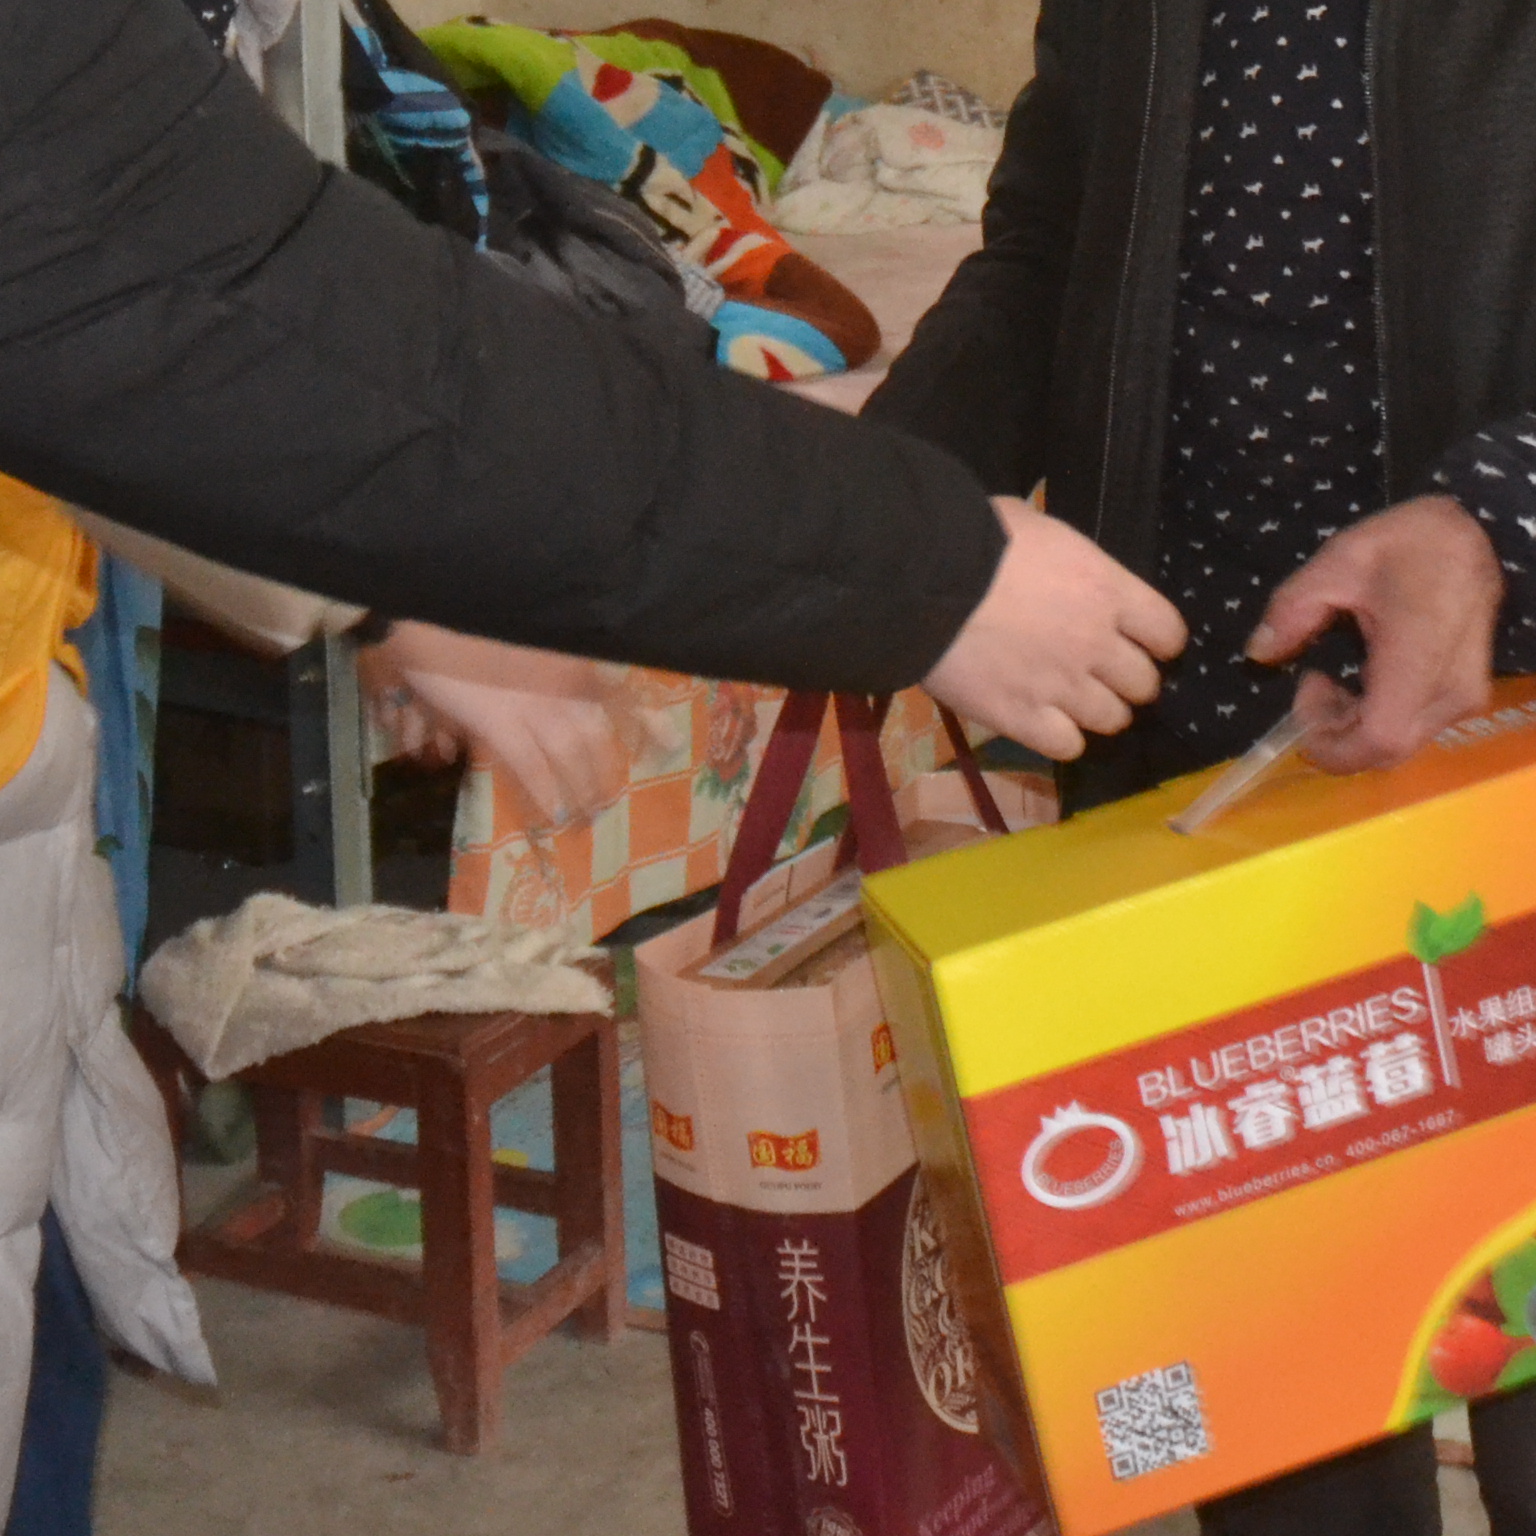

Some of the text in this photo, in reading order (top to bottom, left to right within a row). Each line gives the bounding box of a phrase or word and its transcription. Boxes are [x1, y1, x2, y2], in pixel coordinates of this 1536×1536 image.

[1137, 986, 1425, 1107] BLUEBERRIES
[1159, 1033, 1432, 1177] 冰睿蓝莓
[777, 1239, 847, 1486] 养生粥
